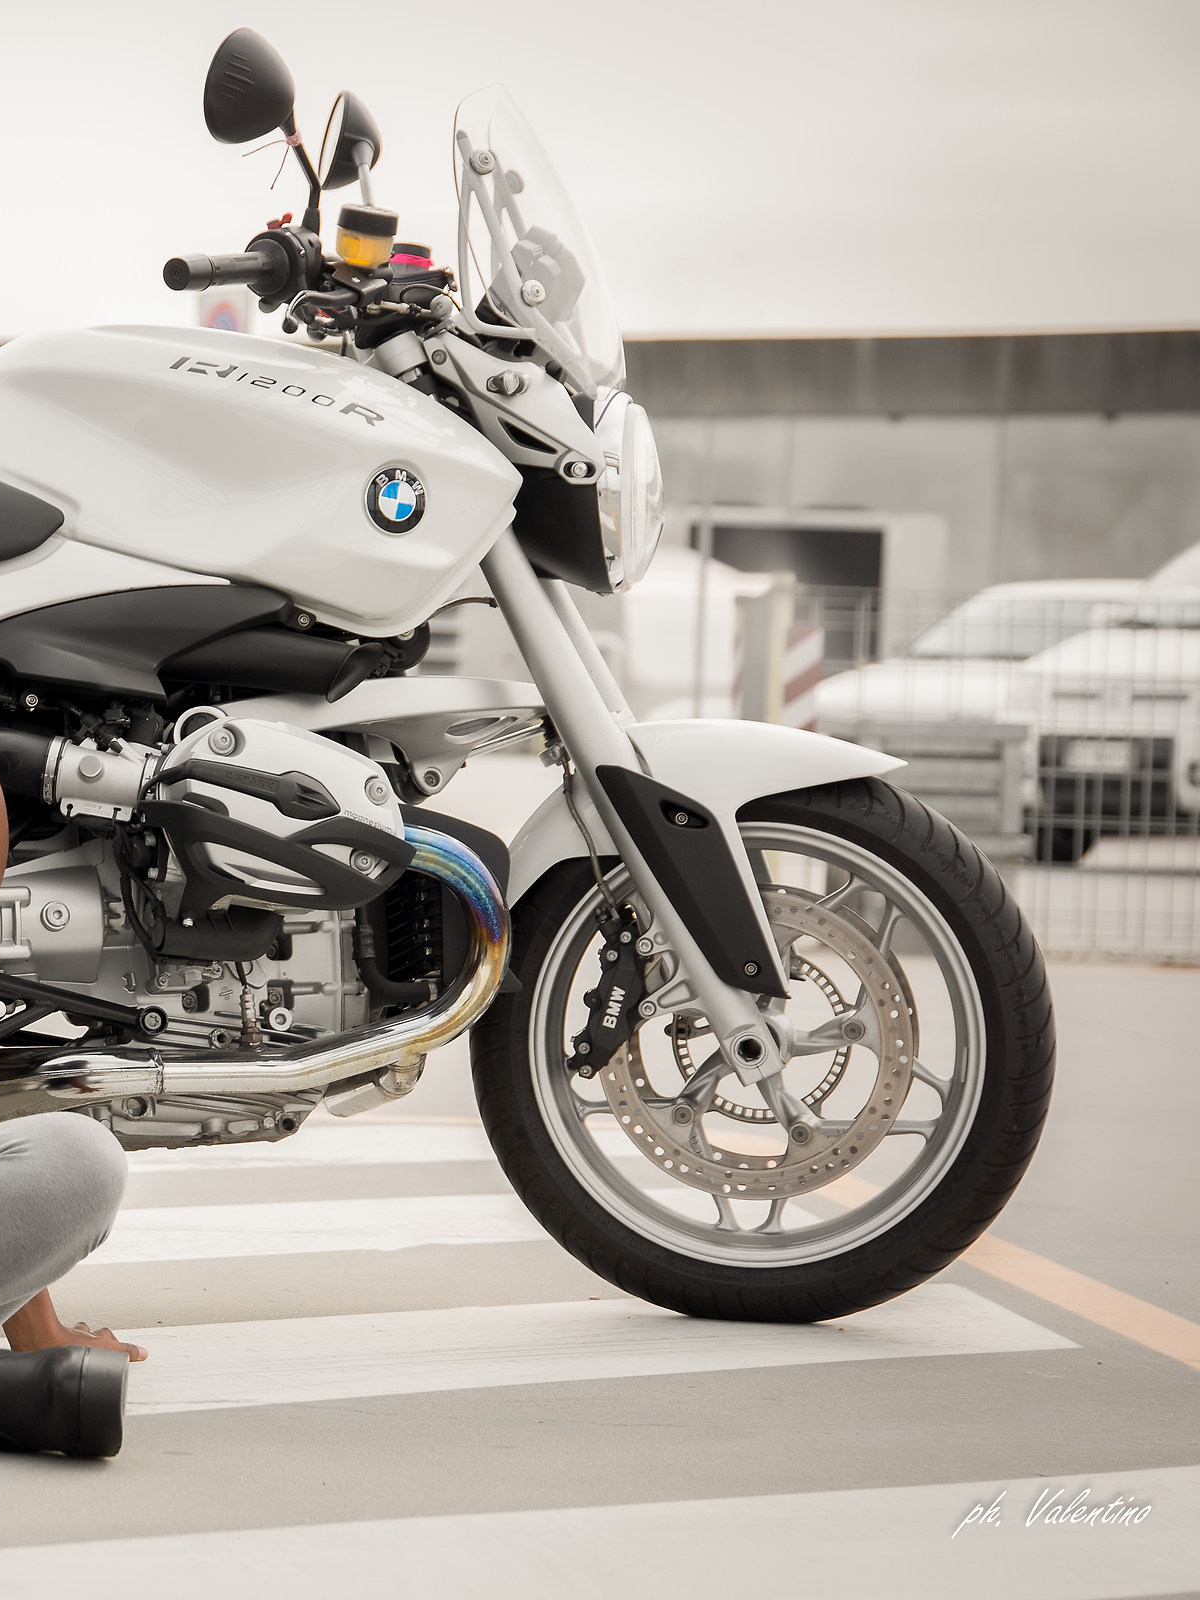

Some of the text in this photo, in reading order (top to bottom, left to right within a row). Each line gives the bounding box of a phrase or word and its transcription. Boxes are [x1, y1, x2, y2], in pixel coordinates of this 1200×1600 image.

[375, 468, 425, 497] BMW
[234, 773, 275, 790] SPARK
[343, 808, 394, 835] magnesium
[601, 985, 626, 1030] BMW
